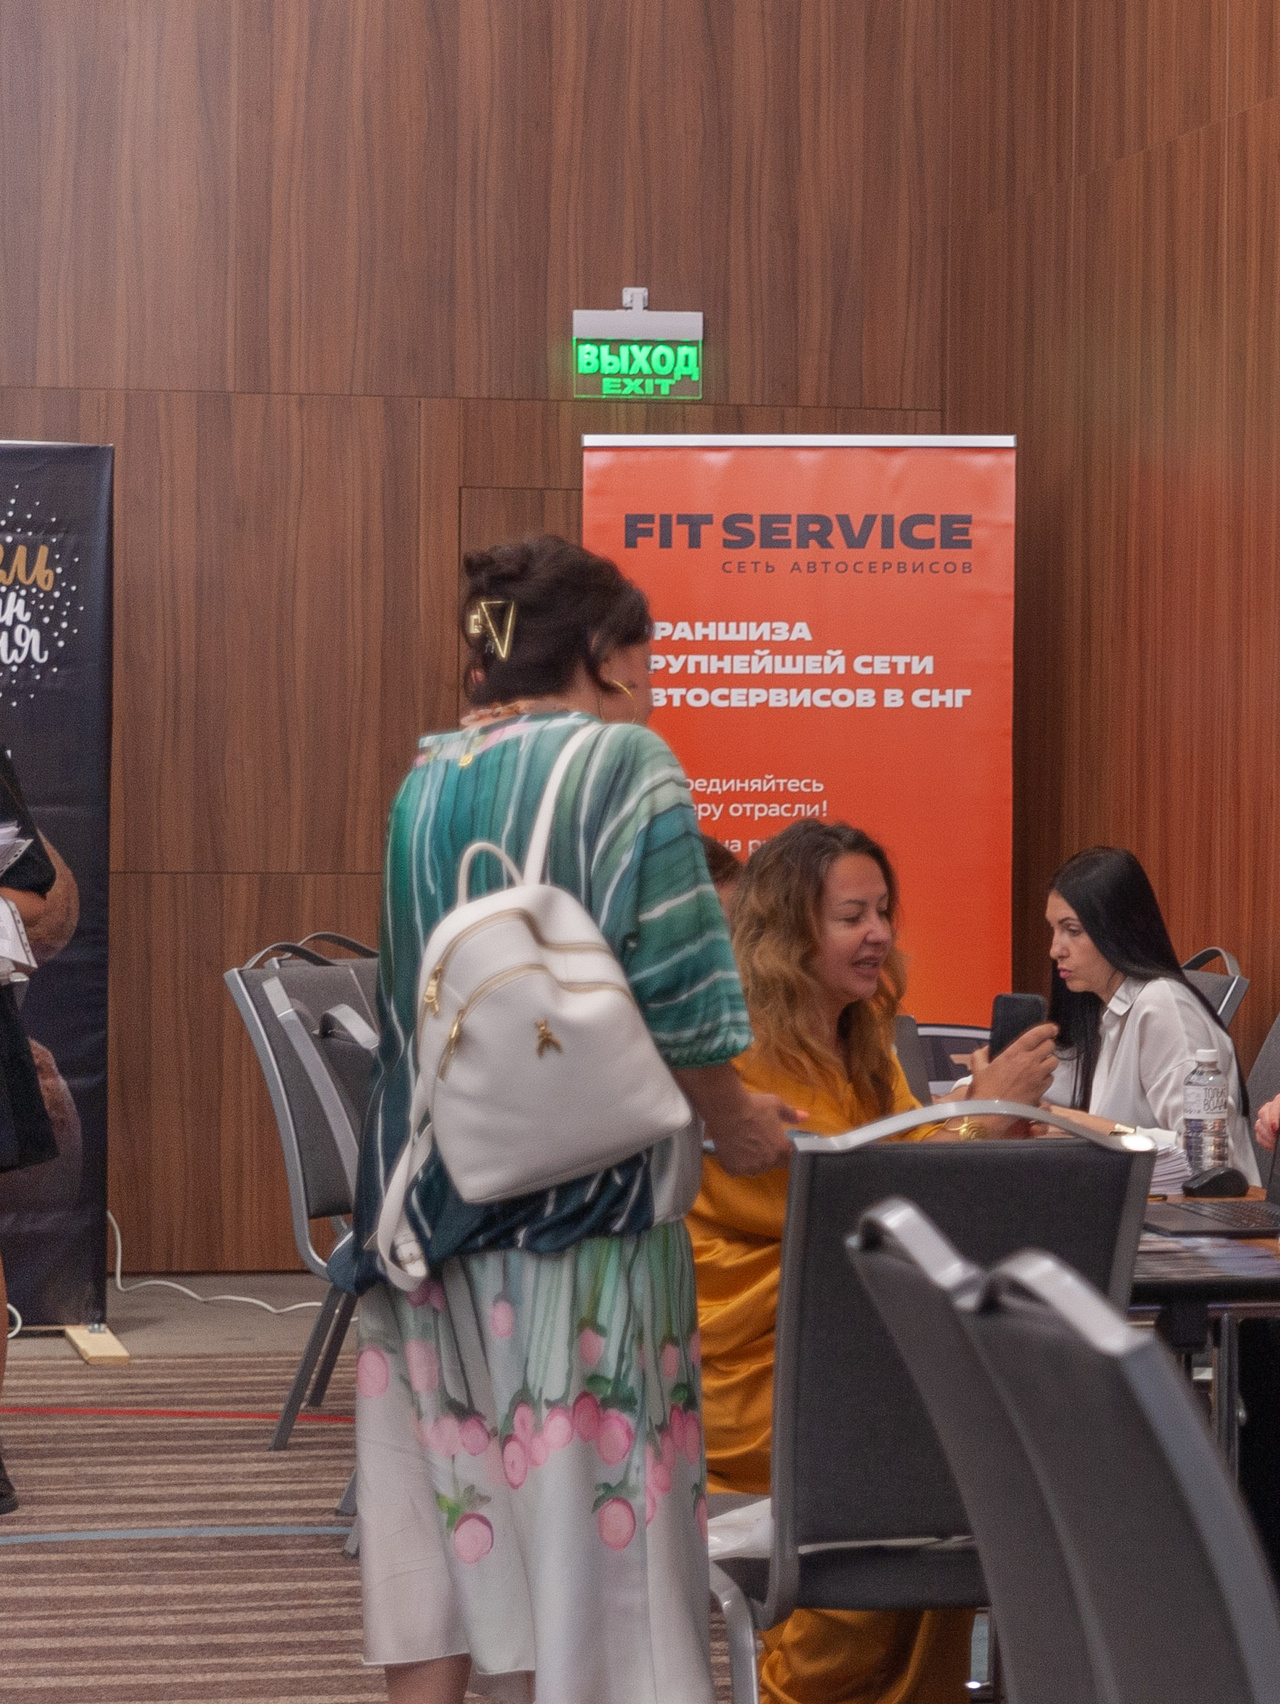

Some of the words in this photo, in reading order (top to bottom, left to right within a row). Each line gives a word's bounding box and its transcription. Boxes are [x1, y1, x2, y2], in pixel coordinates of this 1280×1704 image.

[577, 344, 700, 381] ВЫХОД
[602, 378, 676, 395] EXIT
[624, 513, 713, 549] FIT
[722, 513, 973, 550] SERVICE
[0, 545, 54, 591] ль
[722, 561, 776, 574] СЕТЬ
[790, 561, 973, 575] АВТОСЕРВИСОВ
[651, 621, 812, 641] РАНШИЗА
[648, 649, 846, 675] РУПНЕЙШЕЙ
[853, 655, 934, 675] СЕТИ
[651, 687, 876, 708] ВТОСЕРВИСОВ
[884, 689, 905, 708] В
[911, 689, 972, 709] СНГ
[685, 774, 825, 795] оединяйтесь
[729, 799, 828, 821] отрасли!
